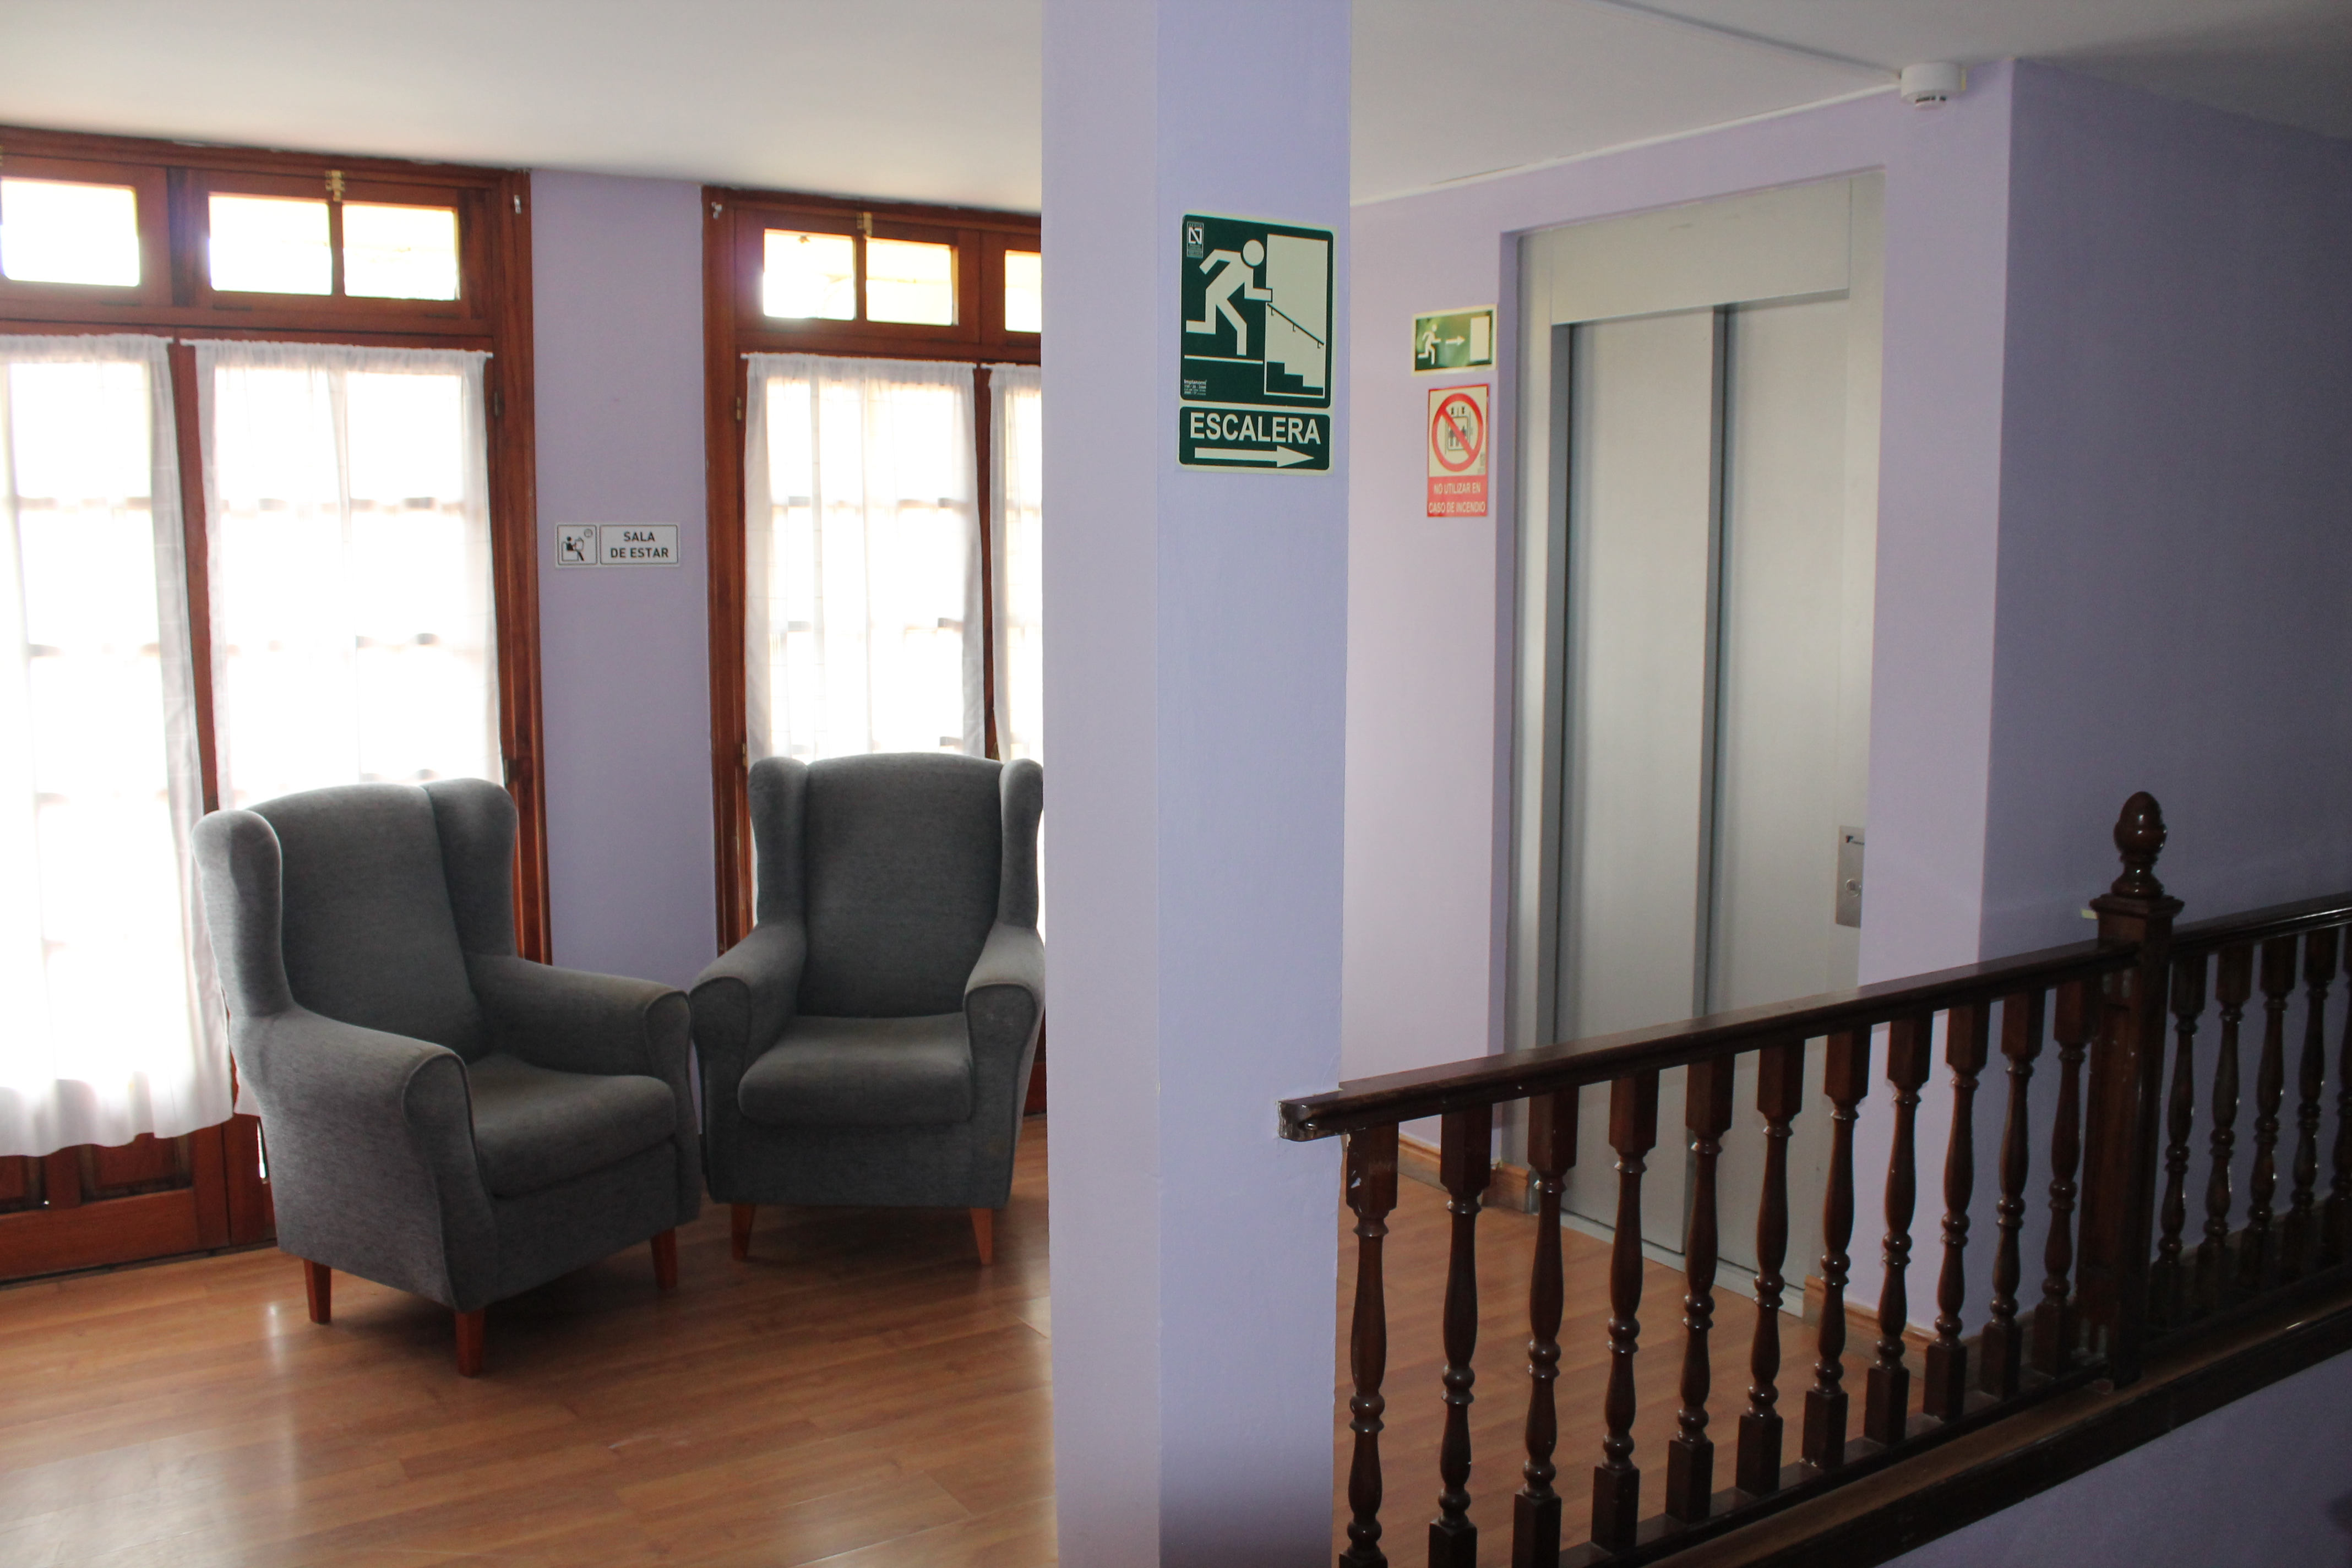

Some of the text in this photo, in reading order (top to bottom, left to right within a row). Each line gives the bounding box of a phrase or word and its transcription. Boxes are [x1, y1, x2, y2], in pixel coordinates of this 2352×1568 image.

[1190, 412, 1321, 444] ESCALERA
[1434, 482, 1480, 494] NO UTILIZAR EN
[1429, 501, 1485, 513] CASO DE INCENDIO
[624, 531, 655, 542] SALA
[611, 548, 668, 558] DE ESTAR
